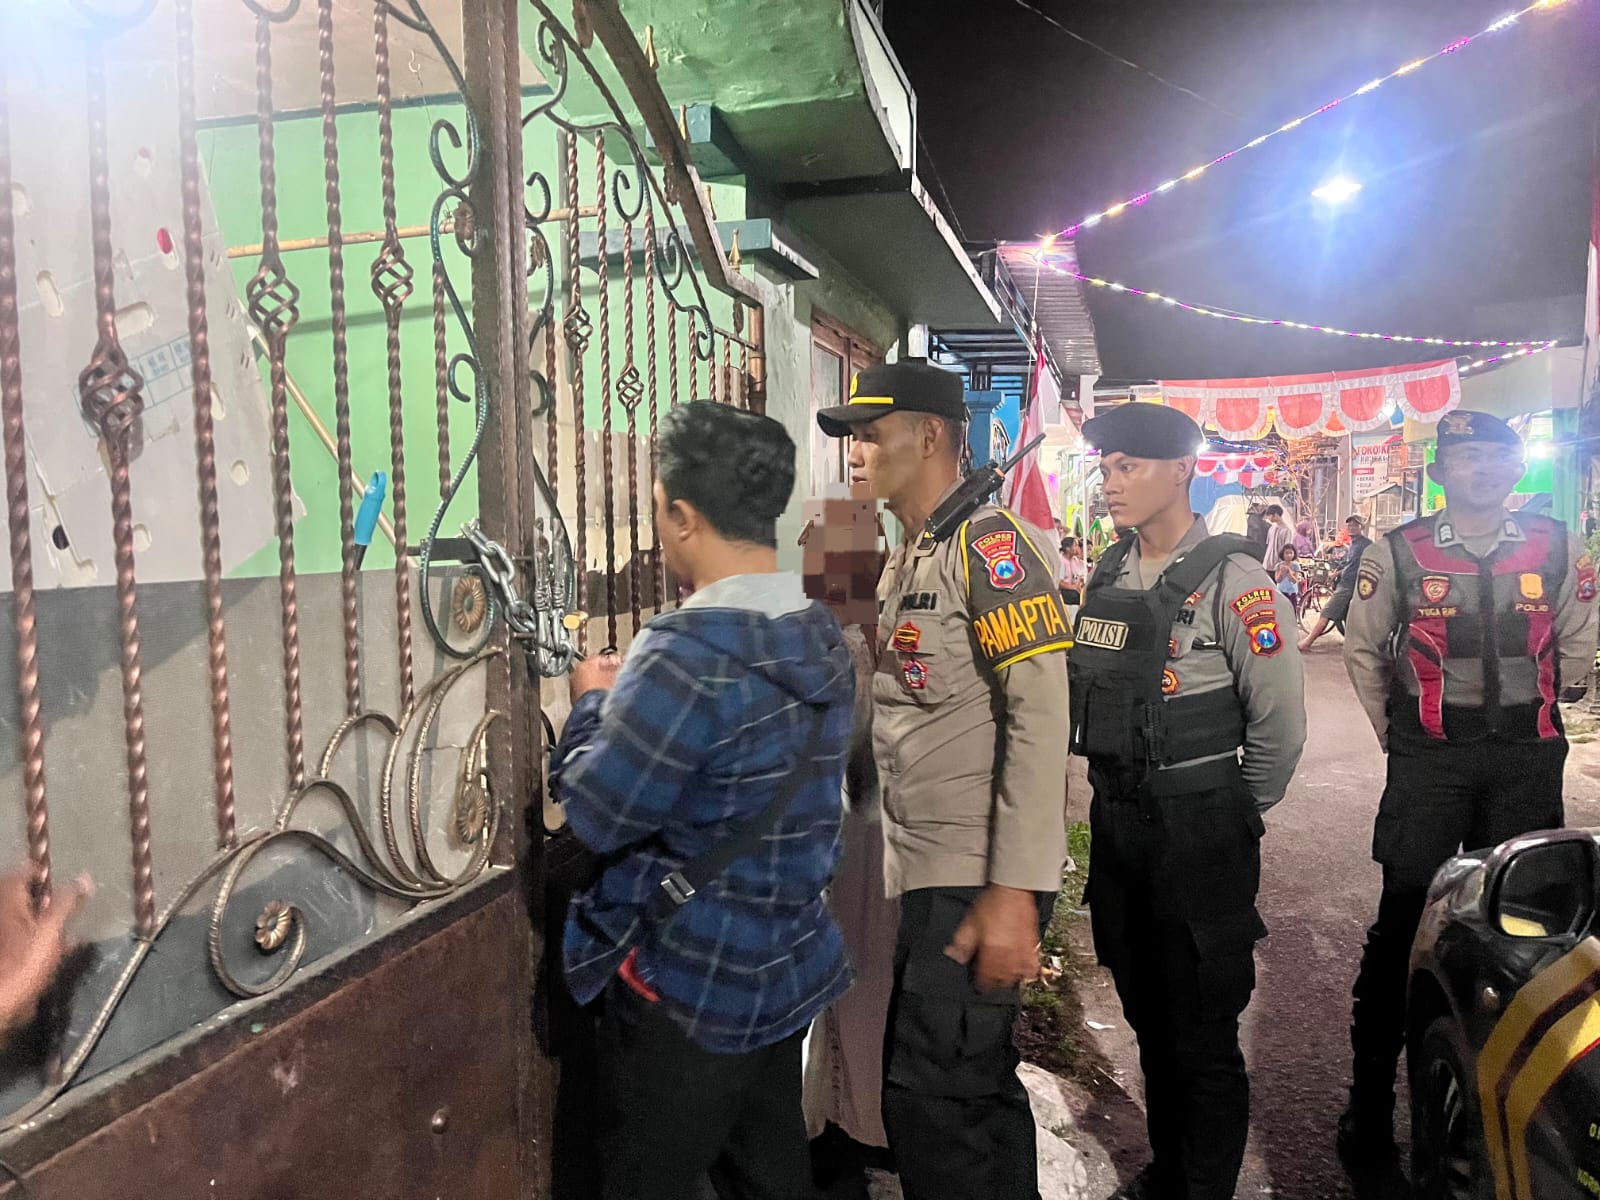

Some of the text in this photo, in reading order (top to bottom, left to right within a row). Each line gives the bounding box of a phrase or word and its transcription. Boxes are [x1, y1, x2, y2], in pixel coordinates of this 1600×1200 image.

[1356, 445, 1379, 455] TOKO
[978, 533, 1012, 548] POLRES
[973, 593, 1067, 659] PAMAPTA
[1079, 620, 1124, 647] POLISI
